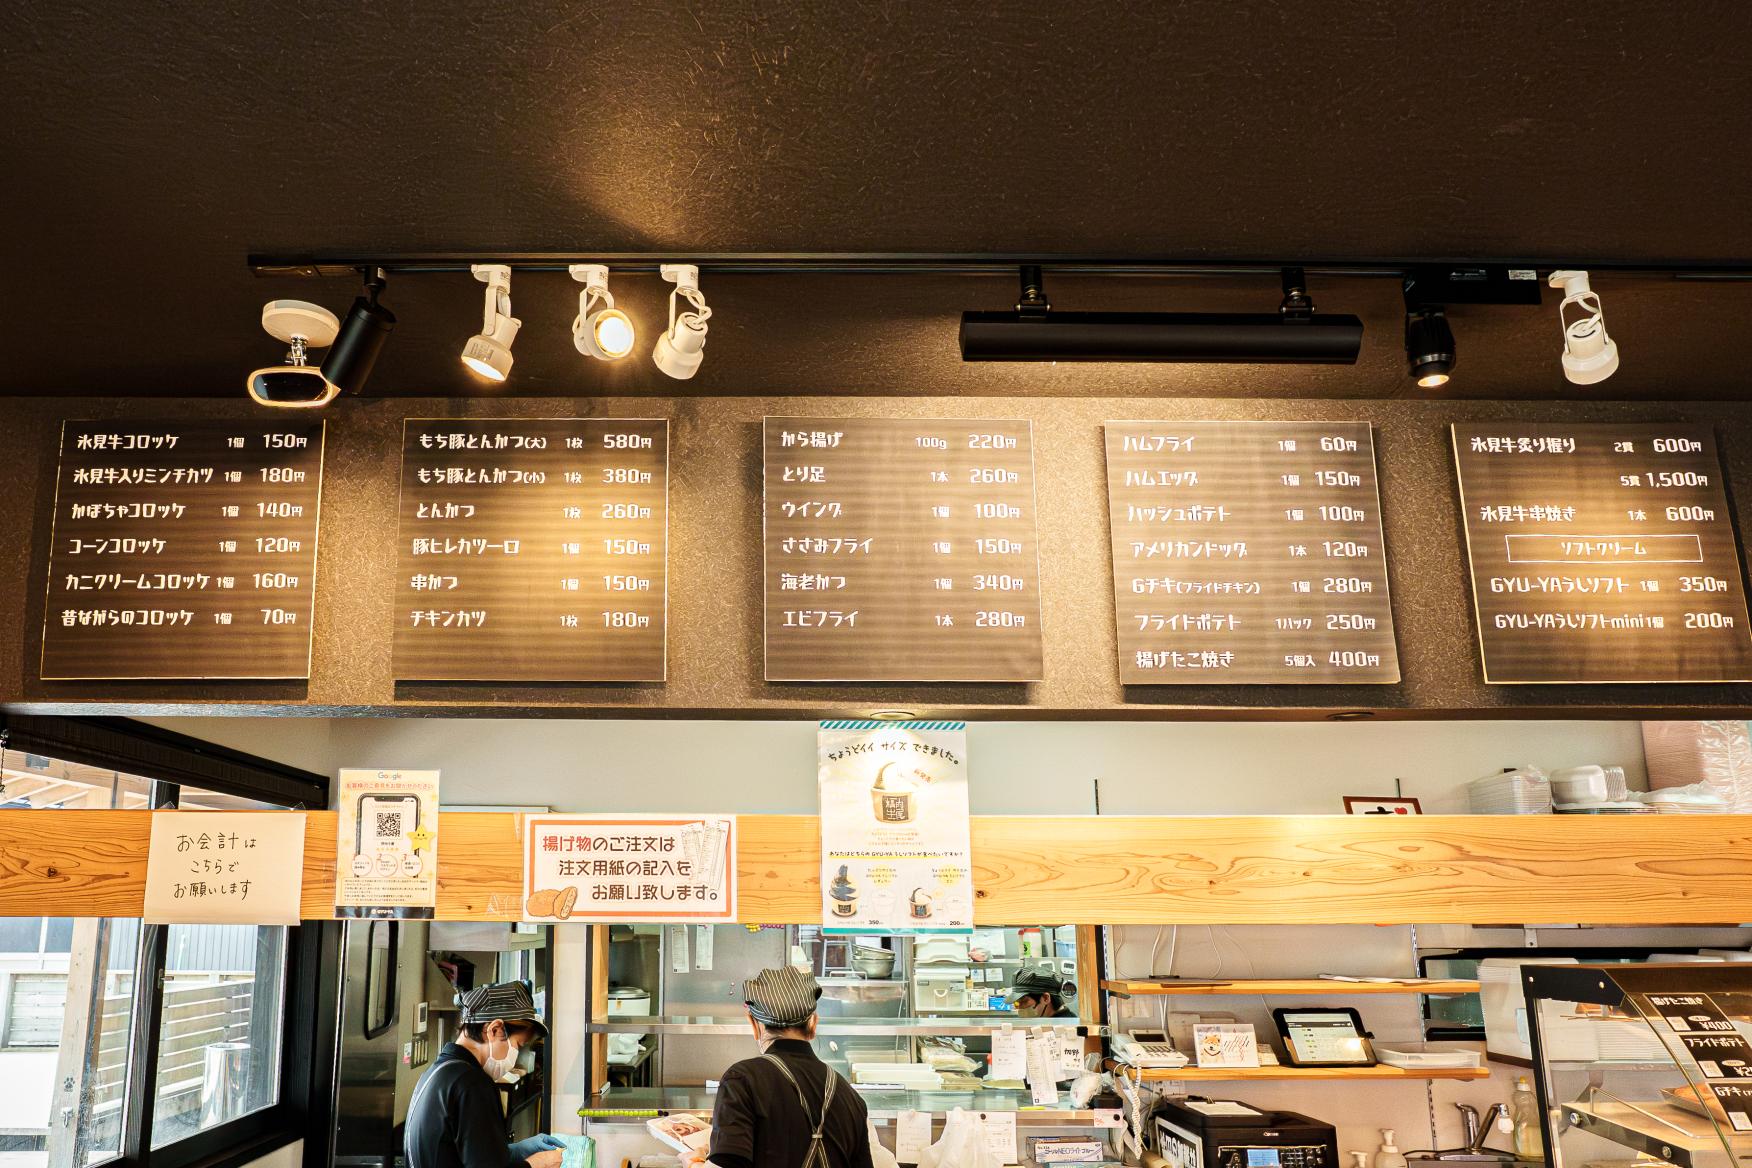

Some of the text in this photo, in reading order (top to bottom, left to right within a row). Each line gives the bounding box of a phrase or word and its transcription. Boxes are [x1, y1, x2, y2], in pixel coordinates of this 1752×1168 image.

[77, 434, 308, 450] 氷見牛コロッケ 1個 150円
[420, 434, 652, 450] もち豚とんかつ(大) 1枚 580円
[781, 432, 1016, 450] から揚げ 100g 220円
[1123, 436, 1357, 452] ハムフライ 1個 60円
[1471, 437, 1702, 454] 氷見牛炙り握り 2貫 600円
[74, 468, 306, 484] 氷見牛入りミンチカツ 1個 180円
[417, 468, 652, 484] もち豚とんかつ(小) 1枚 380円
[782, 466, 1018, 484] とり足 1本 260円
[1126, 471, 1360, 486] ハムエッグ 1個 150円
[1620, 472, 1708, 488] 5貫 1,500円
[72, 502, 303, 519] かぼちゃコロッケ 1個 140円
[416, 503, 651, 519] とんかつ 1枚 260円
[974, 503, 1020, 518] 100円
[1128, 506, 1365, 522] ハッシュポテト 1個 100円
[1480, 506, 1714, 522] 氷見牛串焼き 1本 600円
[68, 538, 301, 554] コーンコロッケ 1個 120円
[412, 538, 520, 554] 豚ヒレカツ一口
[604, 539, 650, 554] 150円
[782, 538, 874, 554] ささみフライ
[975, 538, 1022, 554] 150円
[1288, 545, 1307, 557] 1本
[1322, 542, 1368, 557] 120円
[1560, 542, 1648, 556] ソフトクリーム
[65, 574, 298, 590] カニクリームコロッケ 1個 160円
[410, 574, 458, 590] 串かつ
[603, 575, 650, 590] 150円
[781, 573, 847, 590] 海老かつ
[973, 574, 1024, 590] 340円
[1292, 580, 1310, 593] 1個
[1322, 578, 1372, 593] 280円
[1640, 580, 1660, 592] 1個
[1679, 576, 1728, 592] 350円
[62, 609, 296, 626] 昔ながらのコロッケ 1個 70円
[410, 610, 650, 628] チキンカツ 1枚 180円
[782, 610, 1026, 628] エビフライ 1本 280円
[1134, 614, 1376, 630] フライドポテト 1パック 250円
[1684, 612, 1734, 629] 200円
[1136, 650, 1380, 668] 揚げたこ焼き 5個入 400円
[176, 832, 257, 852] お会計は
[542, 836, 675, 852] 揚げ物のご注文は
[190, 859, 240, 874] こちらで
[559, 860, 692, 876] 注文用紙の記入を
[174, 880, 252, 900] お願いします
[592, 884, 718, 901] お願い致します。
[1699, 1021, 1733, 1030] ¥400
[1685, 1038, 1745, 1047] フライドポテト
